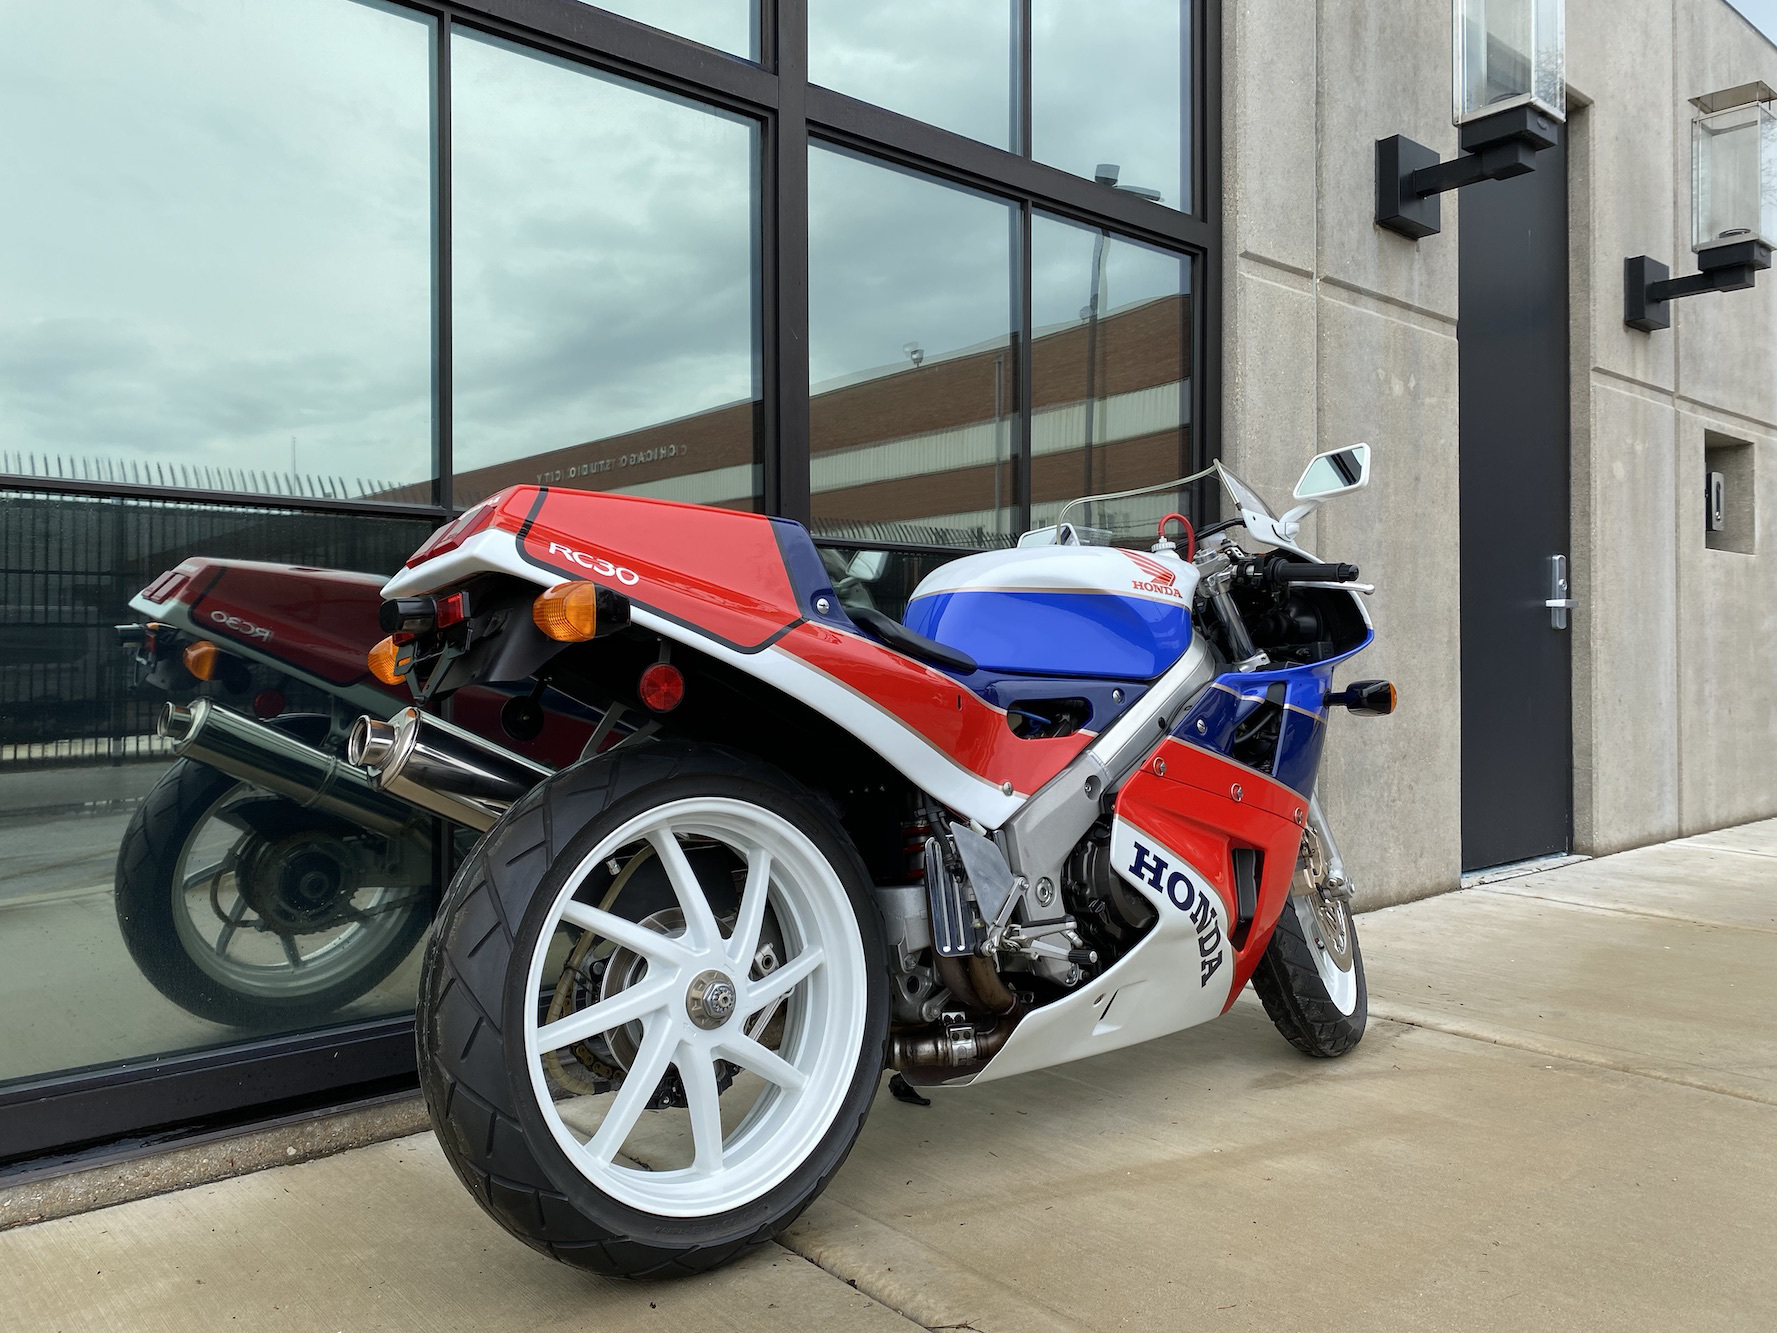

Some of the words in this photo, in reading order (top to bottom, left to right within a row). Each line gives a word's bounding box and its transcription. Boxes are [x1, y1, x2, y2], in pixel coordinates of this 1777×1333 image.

[548, 541, 640, 586] RC30
[1132, 580, 1183, 599] HONDA
[1128, 841, 1223, 988] HONDA
